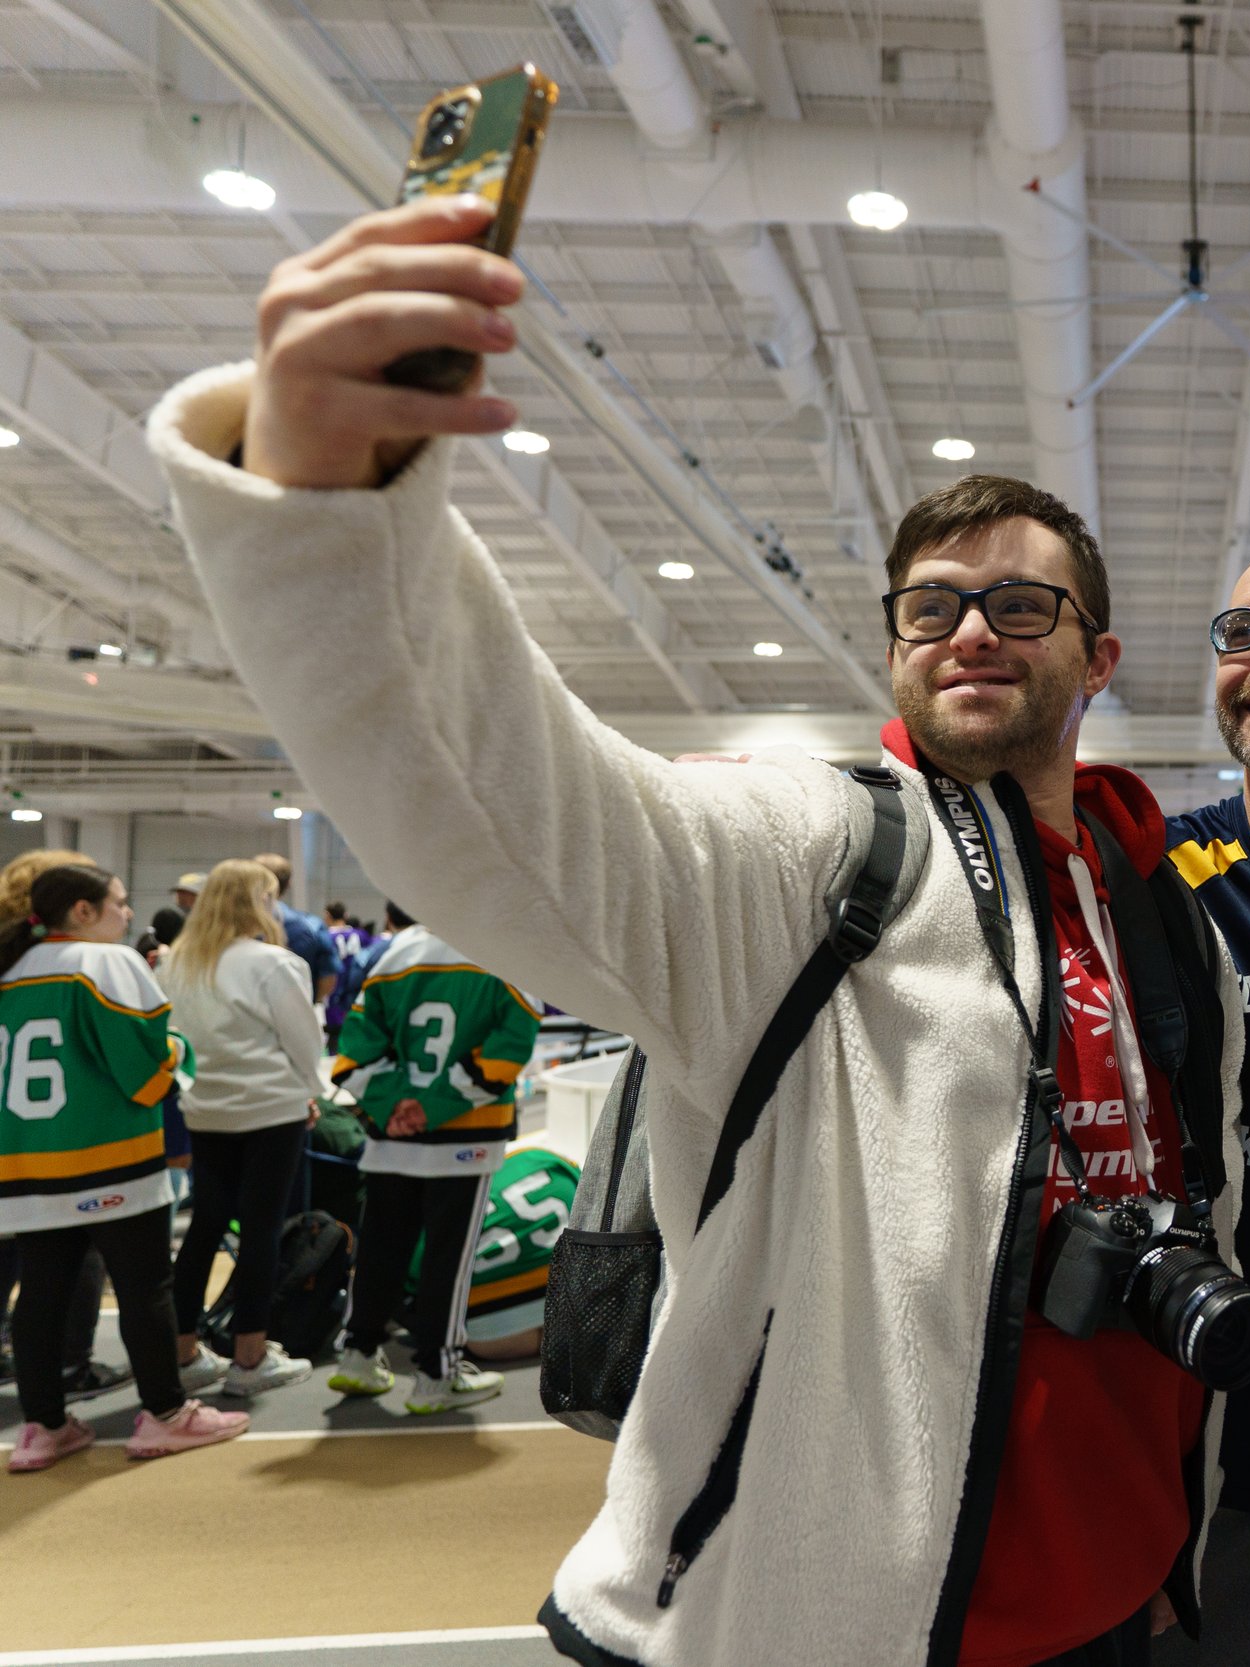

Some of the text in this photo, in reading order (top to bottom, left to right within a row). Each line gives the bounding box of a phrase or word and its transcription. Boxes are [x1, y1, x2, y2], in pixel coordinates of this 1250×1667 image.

[935, 777, 994, 891] OLYMPUS
[409, 1001, 456, 1088] 3
[1169, 1226, 1200, 1238] OLYMPUS
